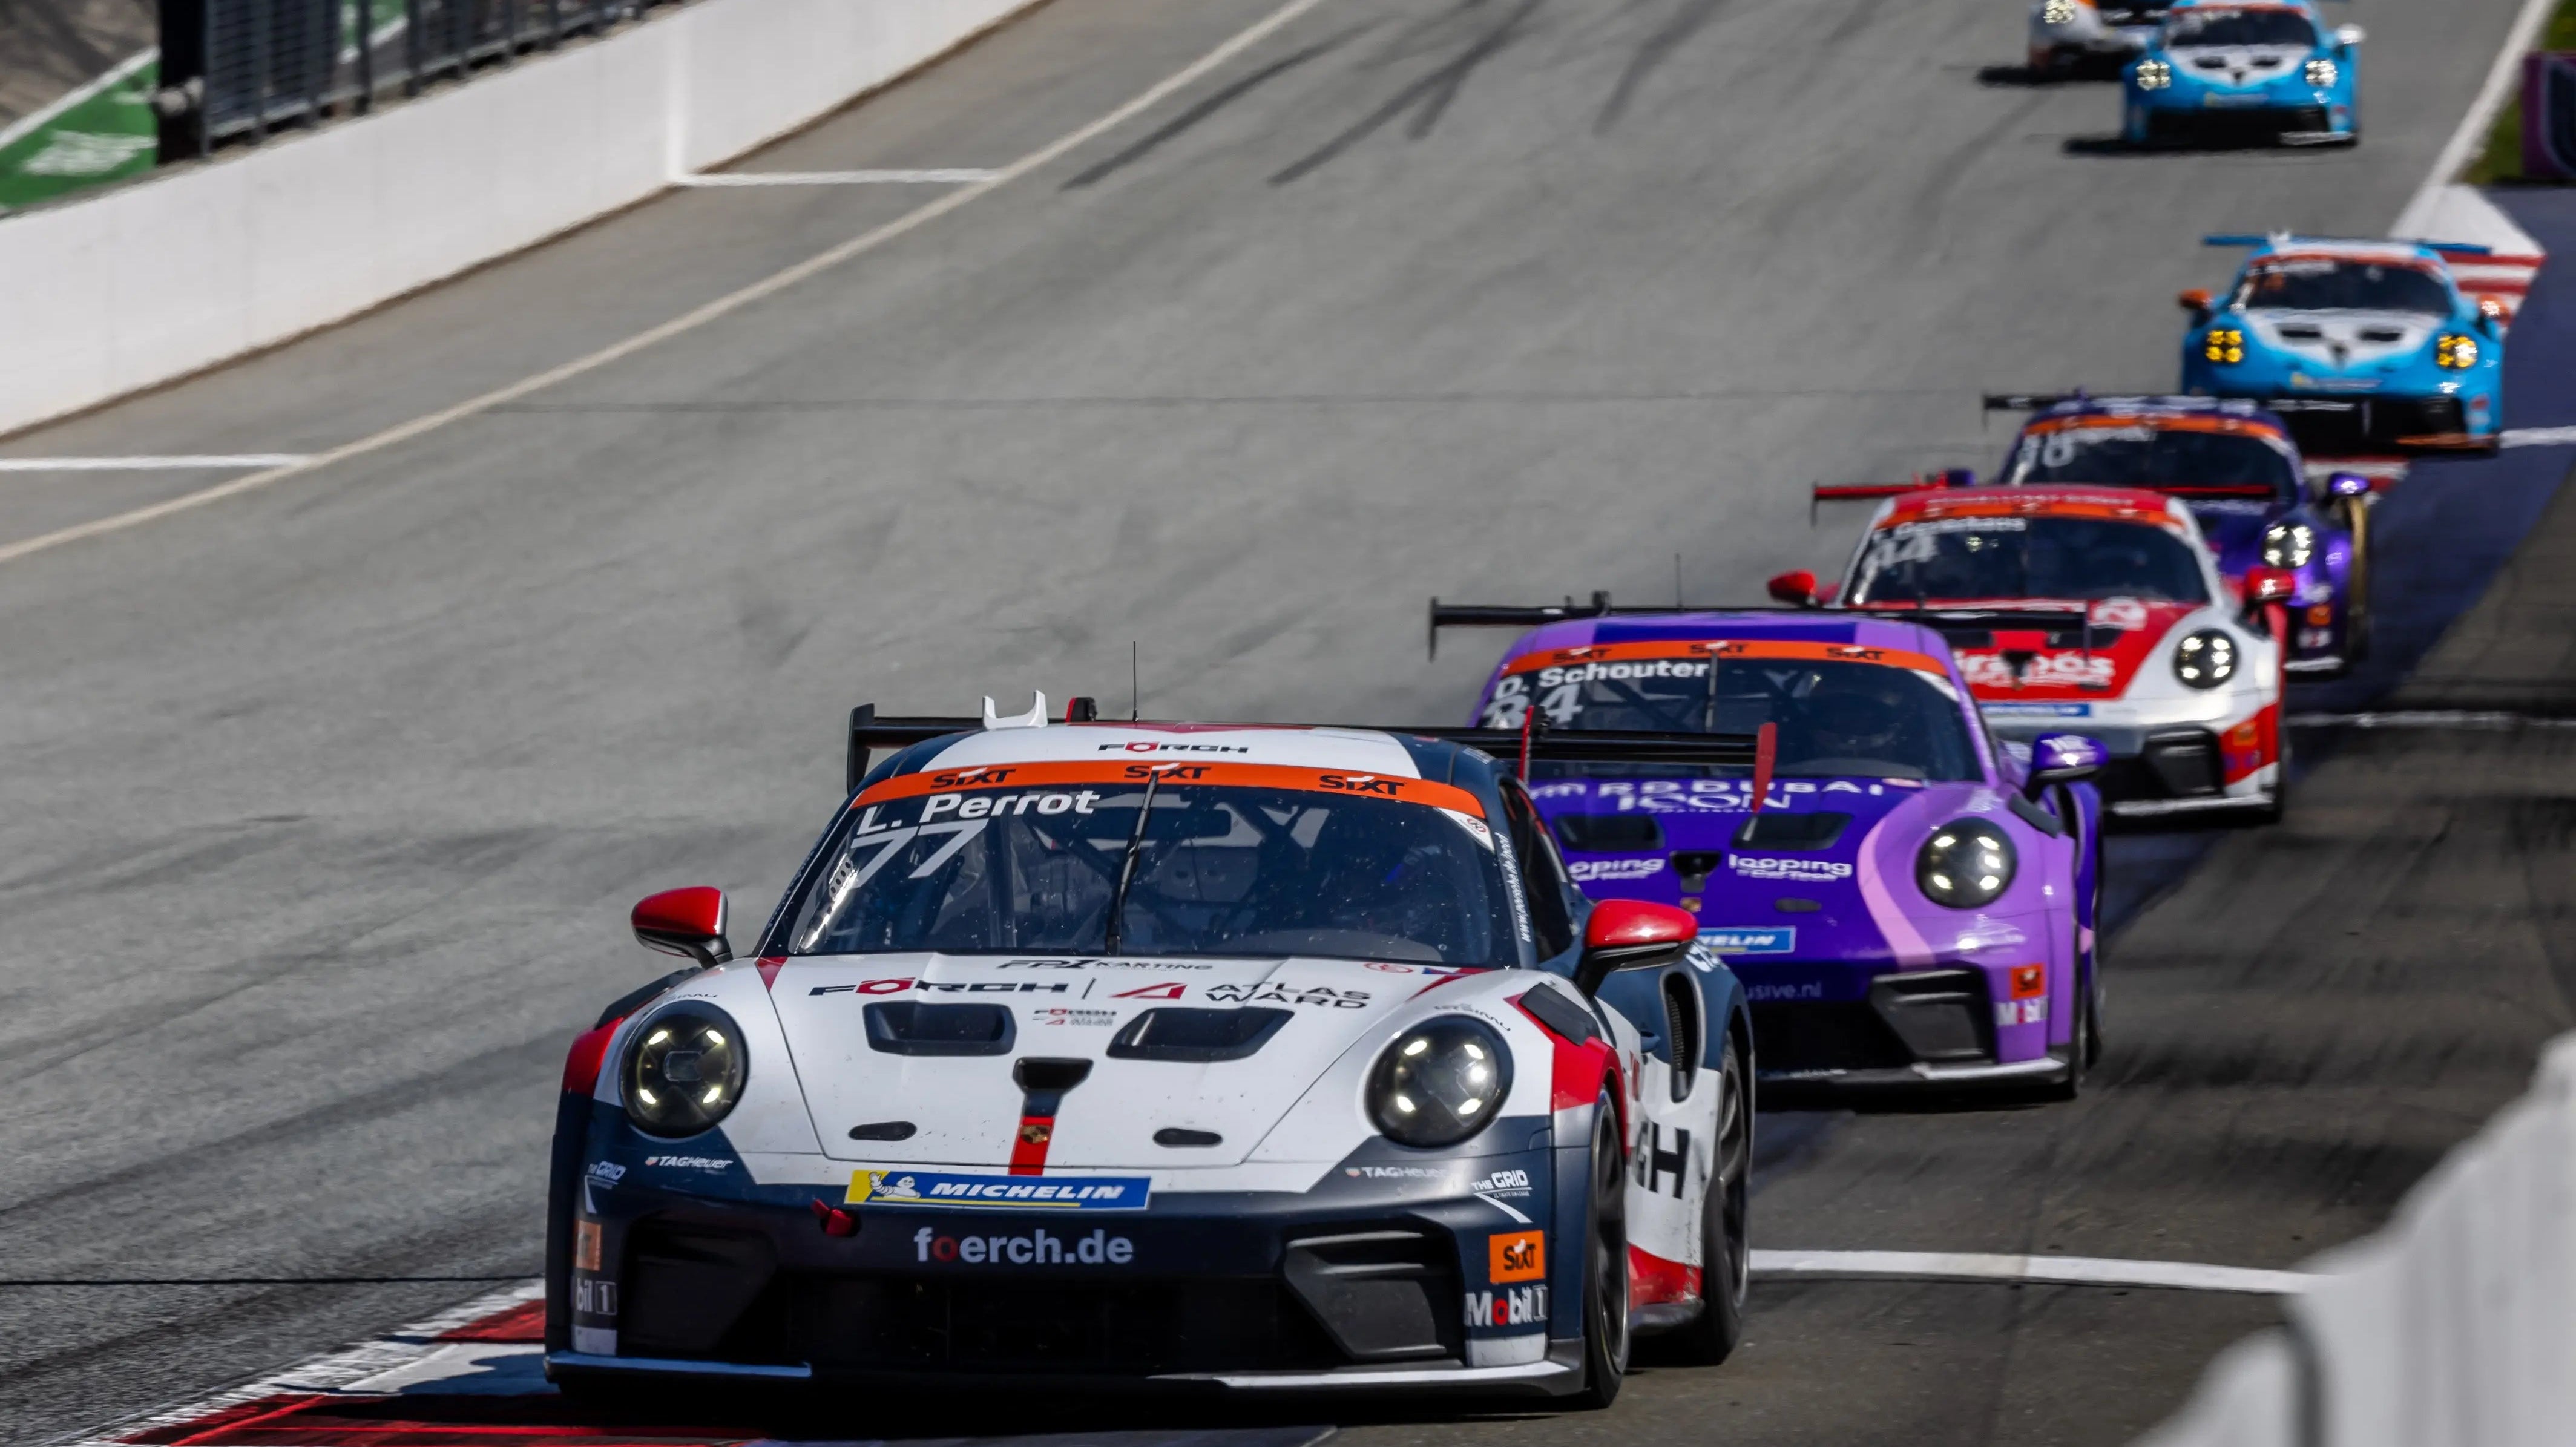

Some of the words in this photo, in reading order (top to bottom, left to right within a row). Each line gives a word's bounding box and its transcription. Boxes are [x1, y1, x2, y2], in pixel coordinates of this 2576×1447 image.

[1494, 675, 1530, 699] D.
[1538, 660, 1710, 688] Schouter
[856, 807, 902, 835] L.
[918, 790, 1101, 824] Perrot
[850, 818, 990, 888] 77
[1729, 853, 1853, 878] looping
[1204, 991, 1369, 1009] WARD
[1208, 981, 1372, 1002] ATLAS
[930, 1182, 1125, 1199] MICHELIN
[1491, 1169, 1529, 1189] GRID
[914, 1227, 1133, 1264] foerch.de
[1464, 1285, 1533, 1327] Mobil
